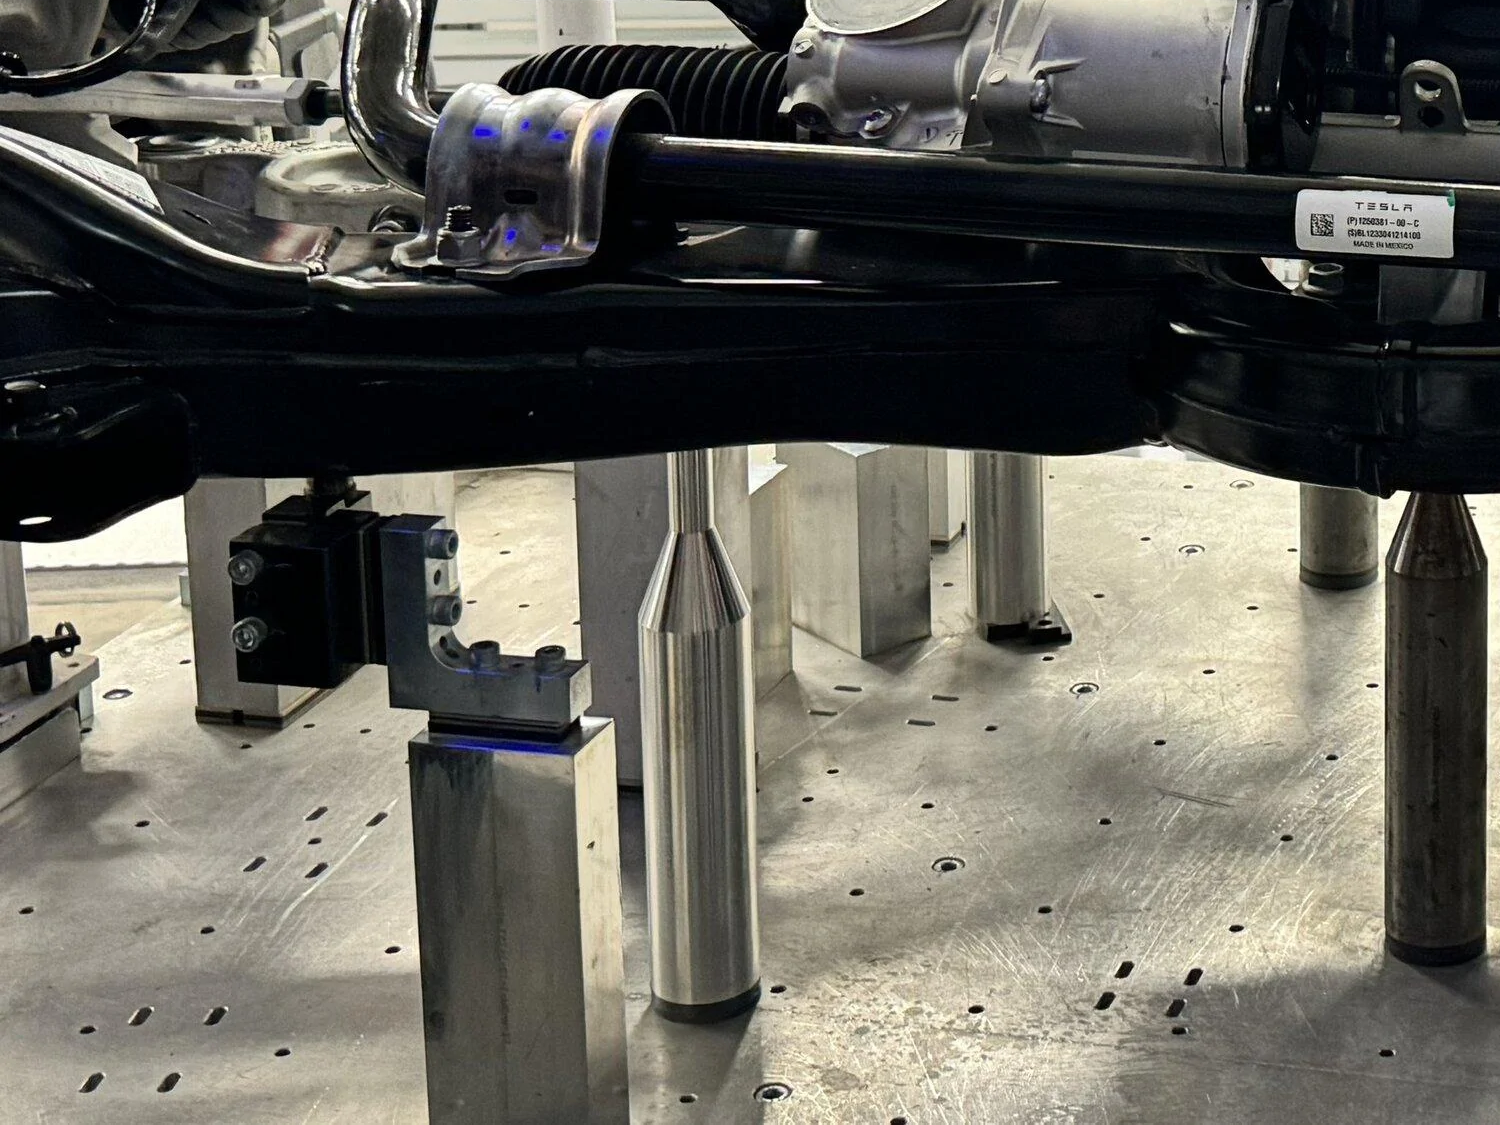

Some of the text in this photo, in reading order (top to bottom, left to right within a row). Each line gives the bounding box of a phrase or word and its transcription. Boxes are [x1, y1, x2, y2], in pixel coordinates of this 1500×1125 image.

[1355, 201, 1413, 212] TESLA
[1353, 240, 1414, 250] MADE IN MEXICO
